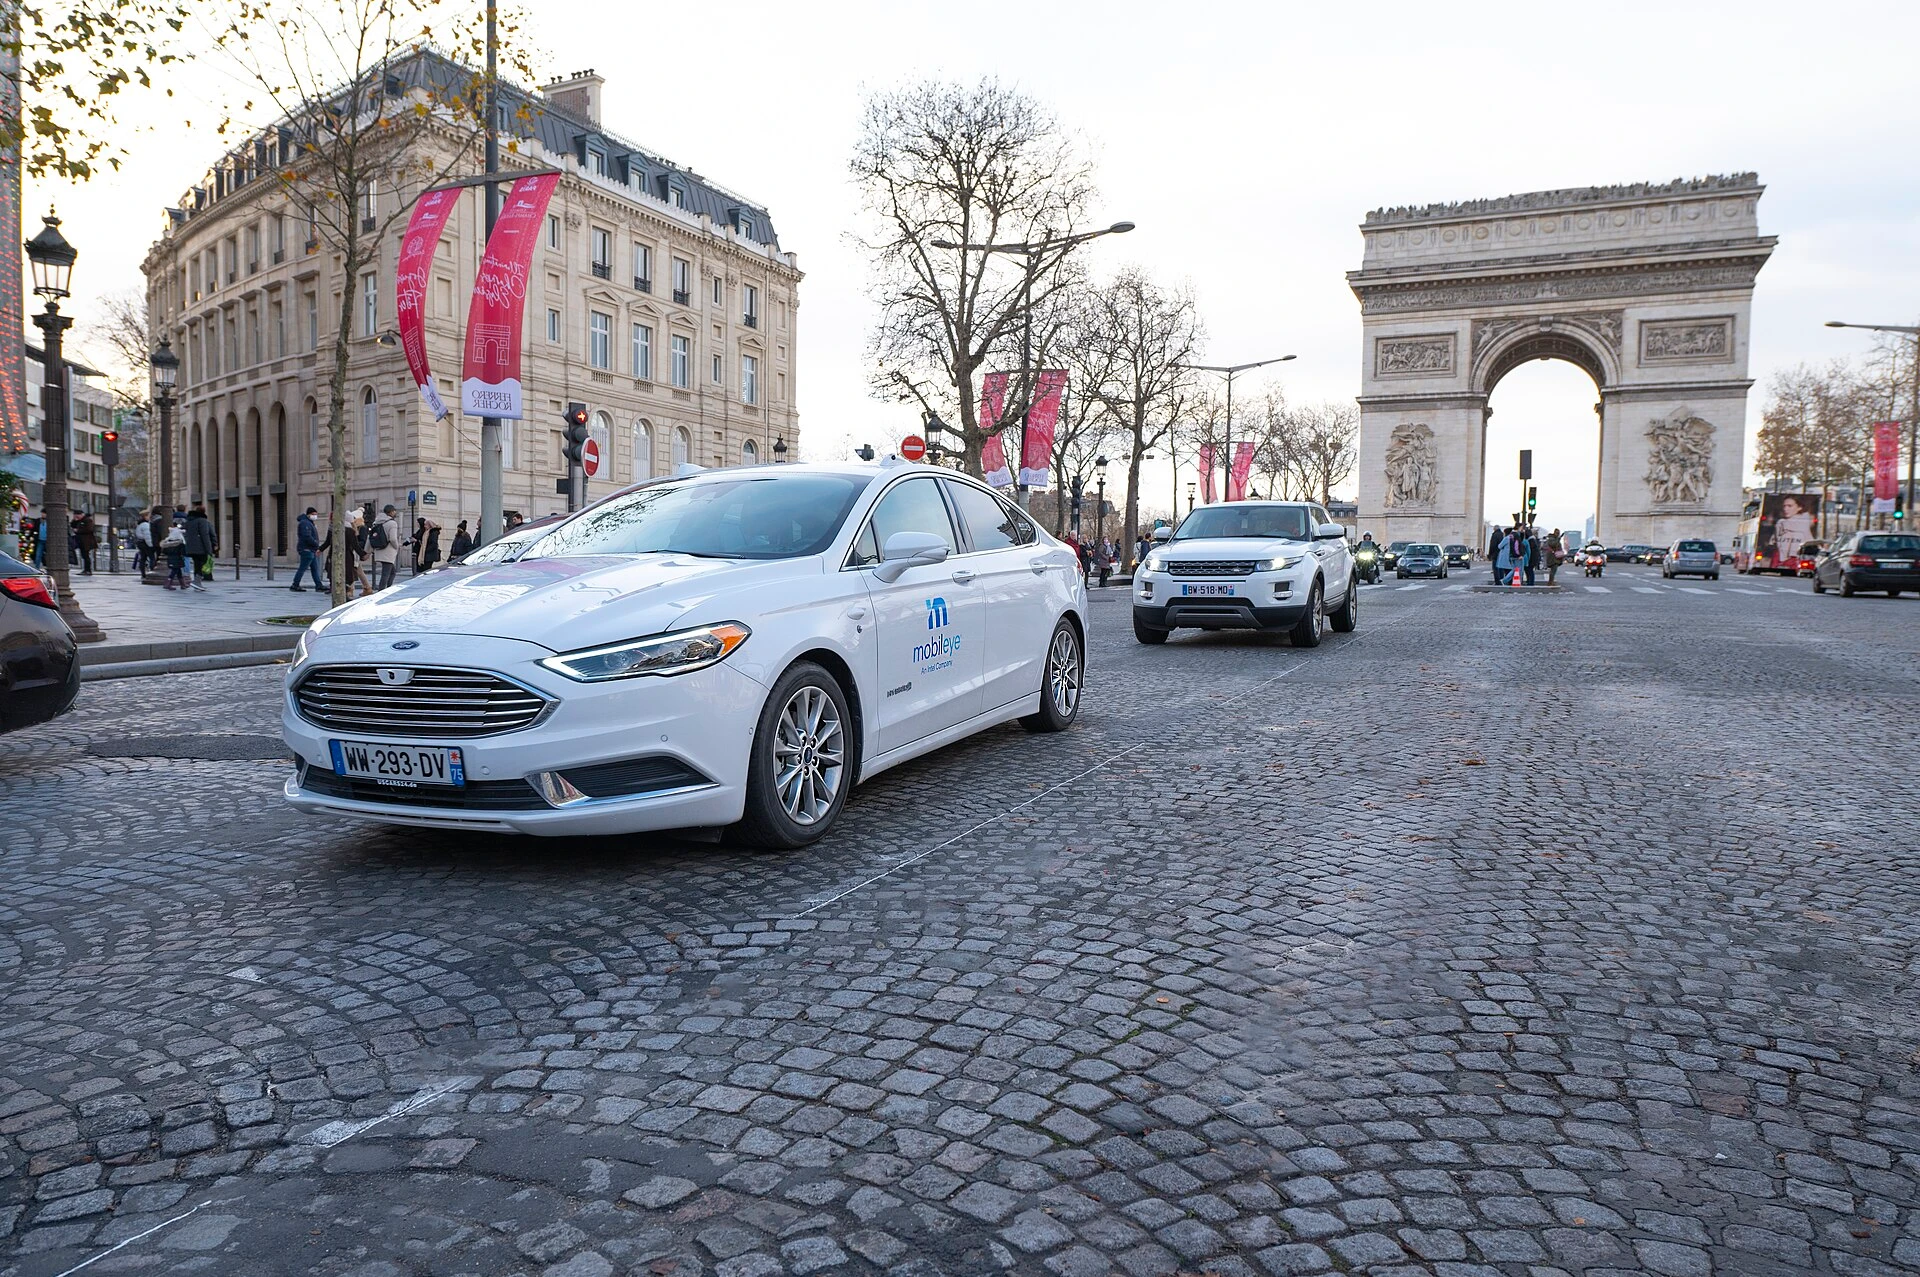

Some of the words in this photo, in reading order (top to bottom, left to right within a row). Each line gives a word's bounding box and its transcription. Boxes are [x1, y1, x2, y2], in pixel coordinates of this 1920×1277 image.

[913, 633, 961, 663] mobileye
[935, 660, 953, 671] Company
[344, 747, 444, 779] WW-293-DV
[451, 768, 464, 781] 75
